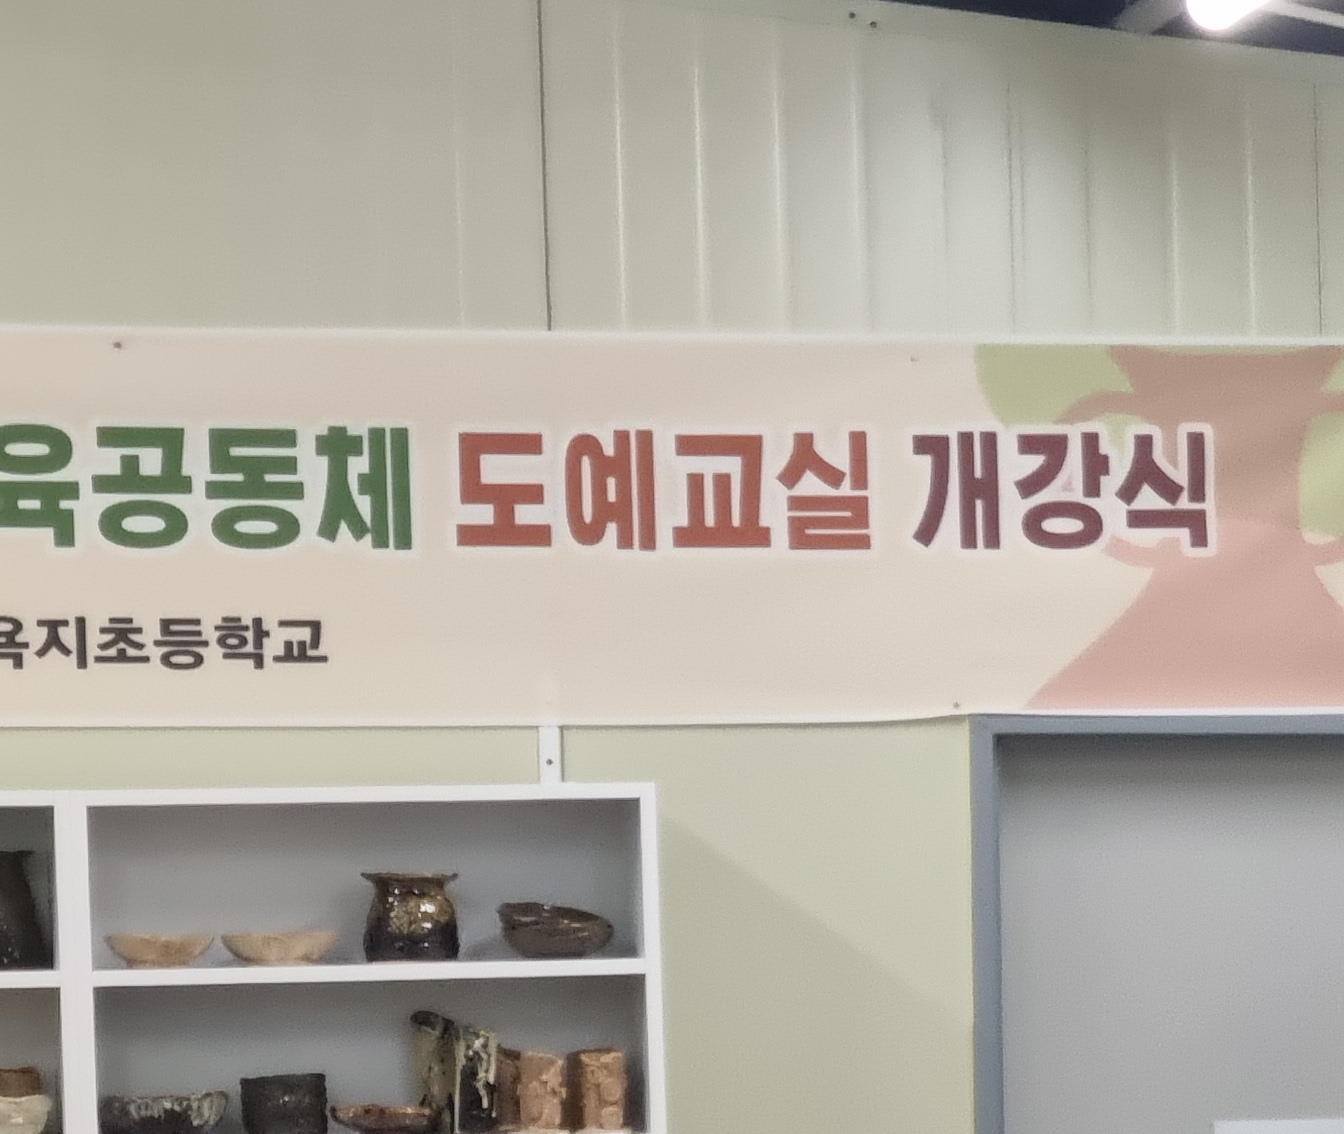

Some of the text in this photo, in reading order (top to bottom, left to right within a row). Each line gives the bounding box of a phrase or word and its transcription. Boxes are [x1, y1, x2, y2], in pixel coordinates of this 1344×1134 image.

[0, 423, 1210, 552] 육공동체 도예교실 개강식
